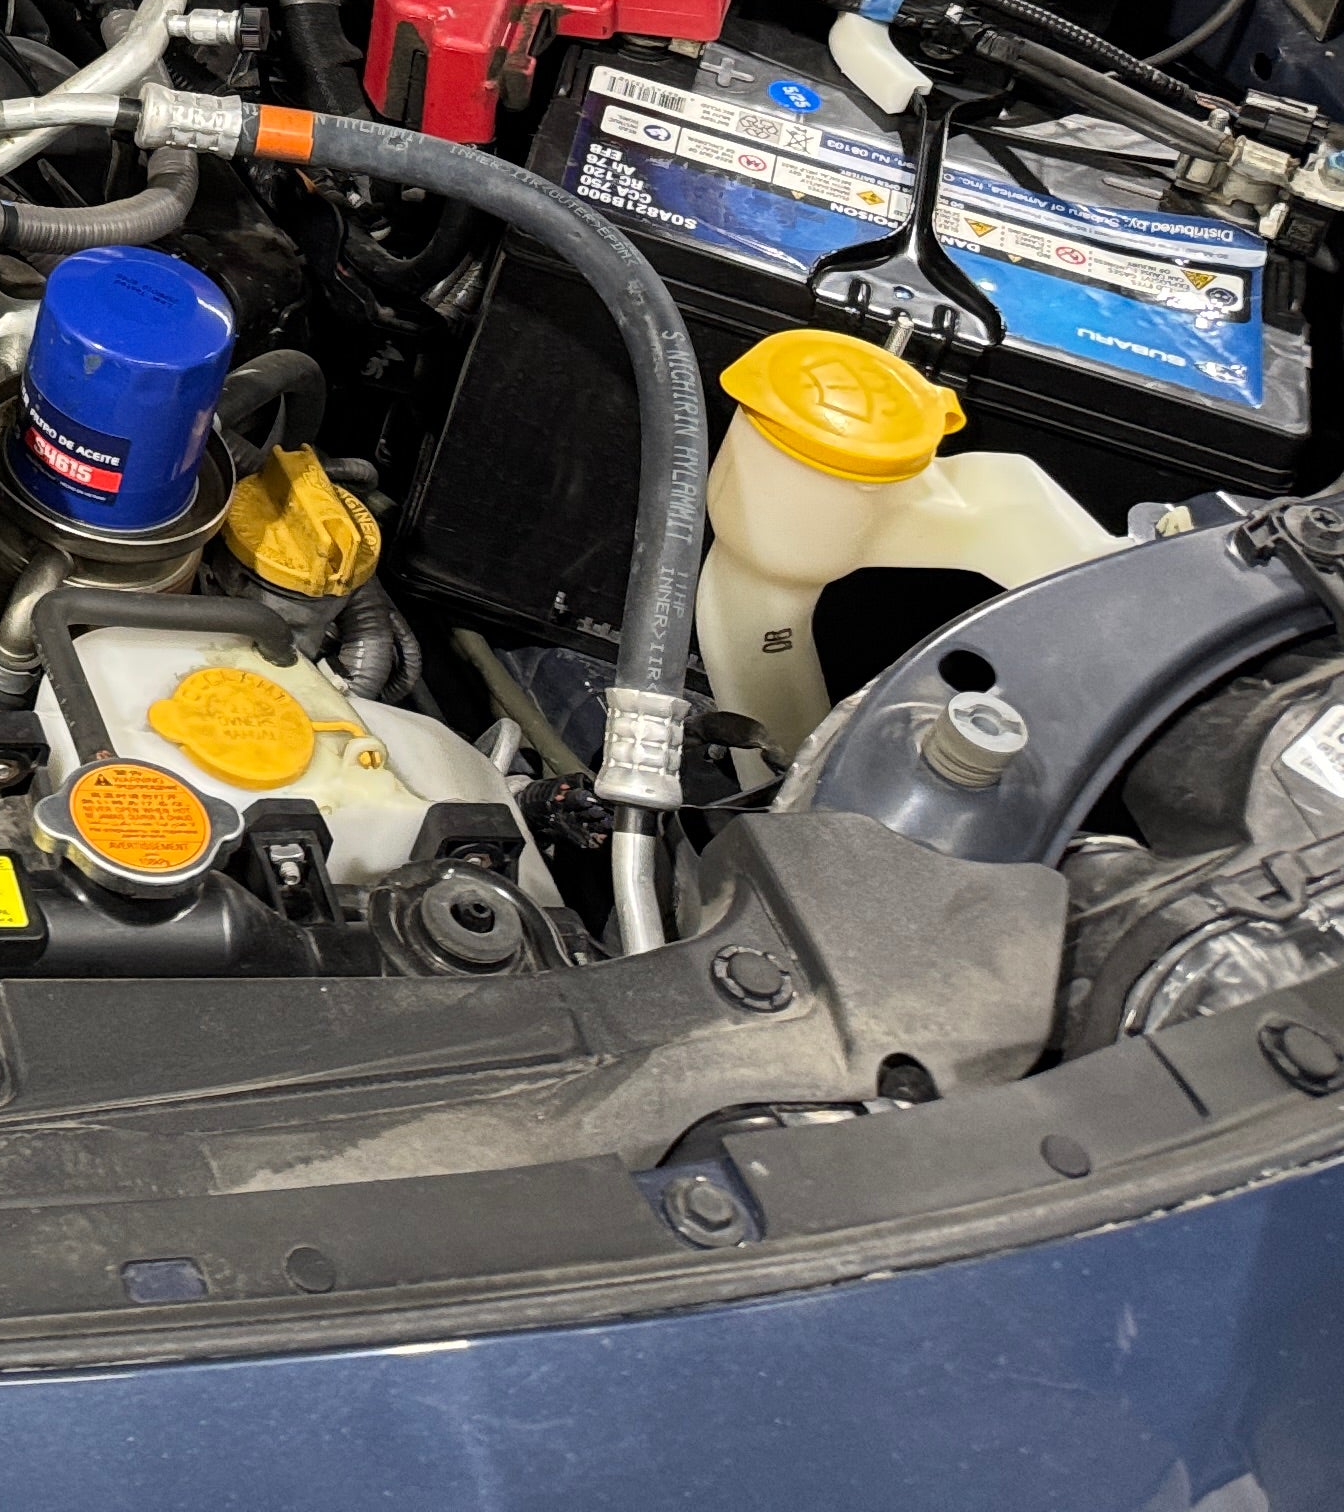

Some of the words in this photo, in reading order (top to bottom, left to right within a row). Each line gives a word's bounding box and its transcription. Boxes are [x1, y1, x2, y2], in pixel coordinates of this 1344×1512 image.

[782, 86, 811, 108] 5/25
[589, 143, 623, 161] EFB
[827, 139, 869, 158] 08103
[586, 153, 608, 167] 76
[871, 152, 891, 164] NJ
[583, 164, 614, 181] 120
[612, 161, 637, 175] Ah
[580, 175, 612, 192] 750
[619, 176, 644, 191] RC
[959, 176, 984, 191] Inc.
[617, 185, 652, 204] CCA
[986, 184, 1047, 208] America,
[830, 203, 898, 229] POISON
[1051, 204, 1066, 212] of
[1069, 209, 1120, 229] Subaru
[1150, 222, 1234, 242] Distributed
[1077, 328, 1187, 367] SUBARU
[58, 434, 74, 450] DE
[75, 445, 120, 467] ACEITE
